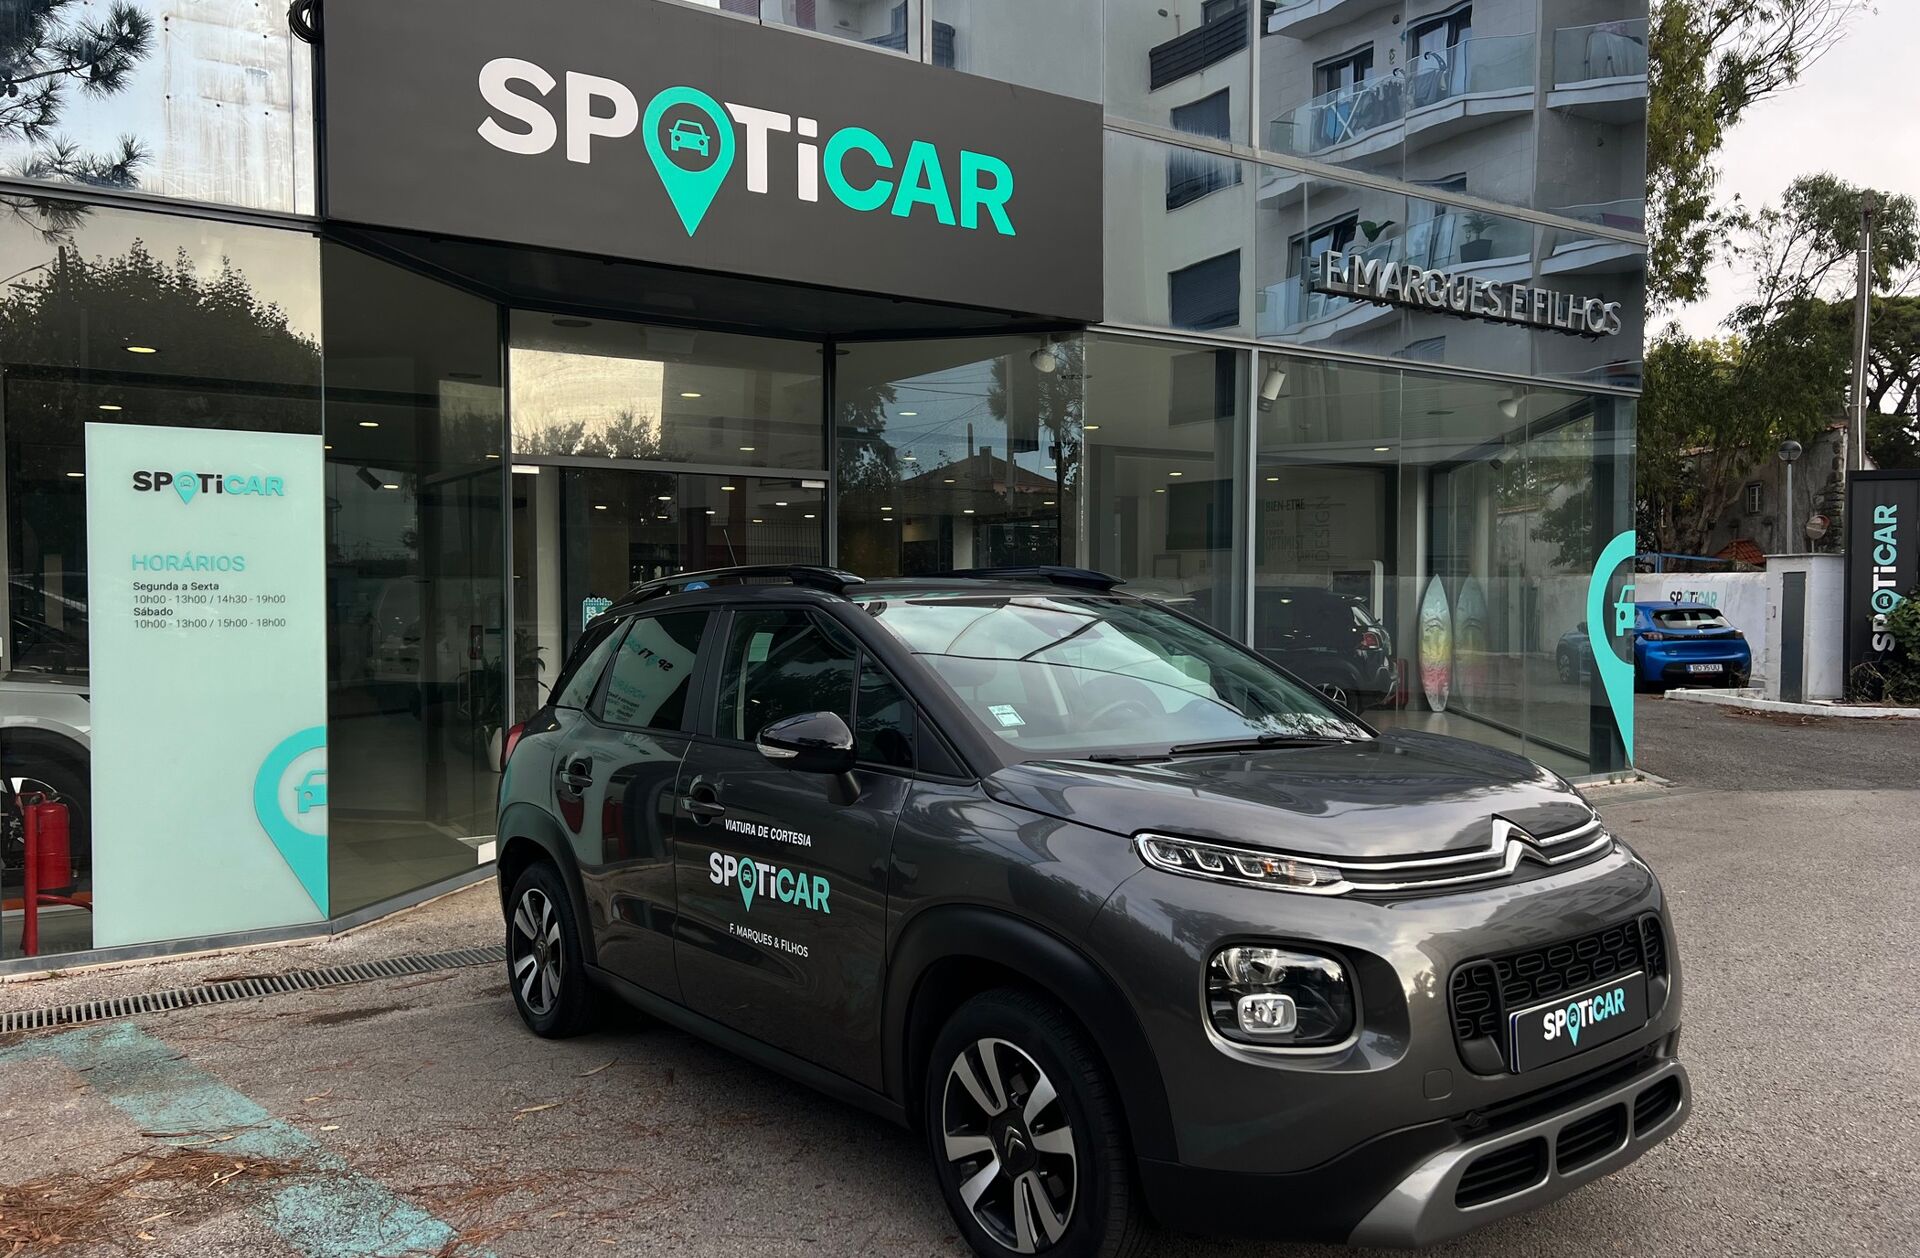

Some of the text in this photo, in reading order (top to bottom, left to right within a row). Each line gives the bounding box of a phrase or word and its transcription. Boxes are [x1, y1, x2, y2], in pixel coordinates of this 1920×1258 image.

[1348, 254, 1502, 317] MARQUES
[1530, 287, 1622, 336] FILHOS
[131, 552, 246, 571] HORÁRIOS
[133, 581, 220, 592] Segunda a Sexta
[134, 594, 166, 604] 10h00
[176, 594, 207, 604] 13h00
[217, 594, 248, 604] 14h30
[256, 594, 286, 604] 19h00
[133, 606, 174, 616] Sábado
[134, 619, 166, 629] 10h00
[176, 618, 207, 628] 13h00
[217, 618, 248, 628] 15h00
[256, 618, 286, 627] 18h00
[725, 818, 812, 847] VIATURA DE CORTESIA
[729, 923, 809, 958] F. MARQUES & FILHOS
